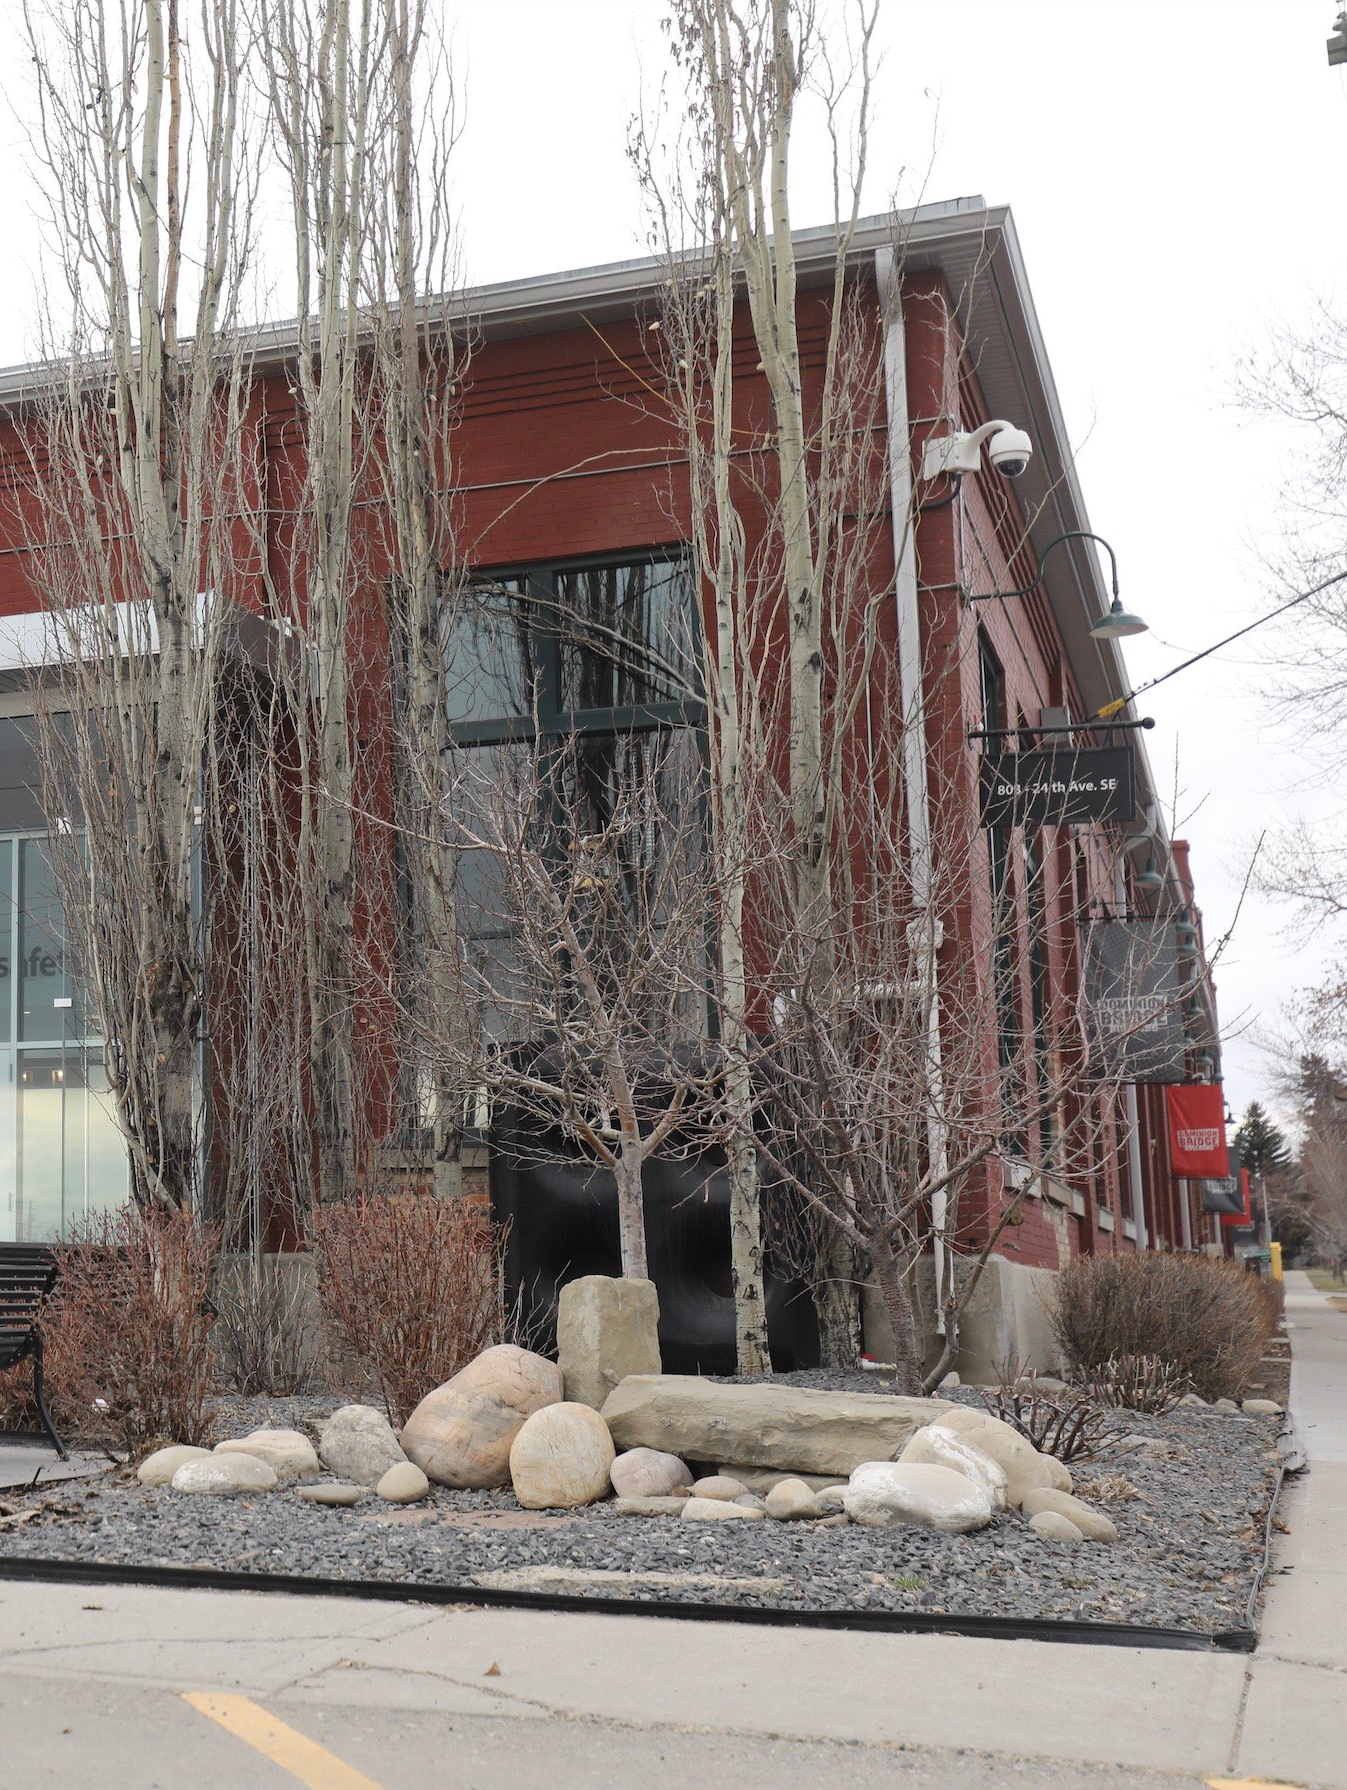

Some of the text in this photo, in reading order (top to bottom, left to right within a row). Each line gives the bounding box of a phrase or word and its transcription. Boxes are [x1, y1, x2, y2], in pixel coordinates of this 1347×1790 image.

[997, 784, 1021, 796] 803
[1069, 780, 1097, 792] Ave.
[1100, 778, 1116, 791] SE
[1178, 1129, 1218, 1138] DOMINION
[1179, 1136, 1218, 1147] BRIDGE
